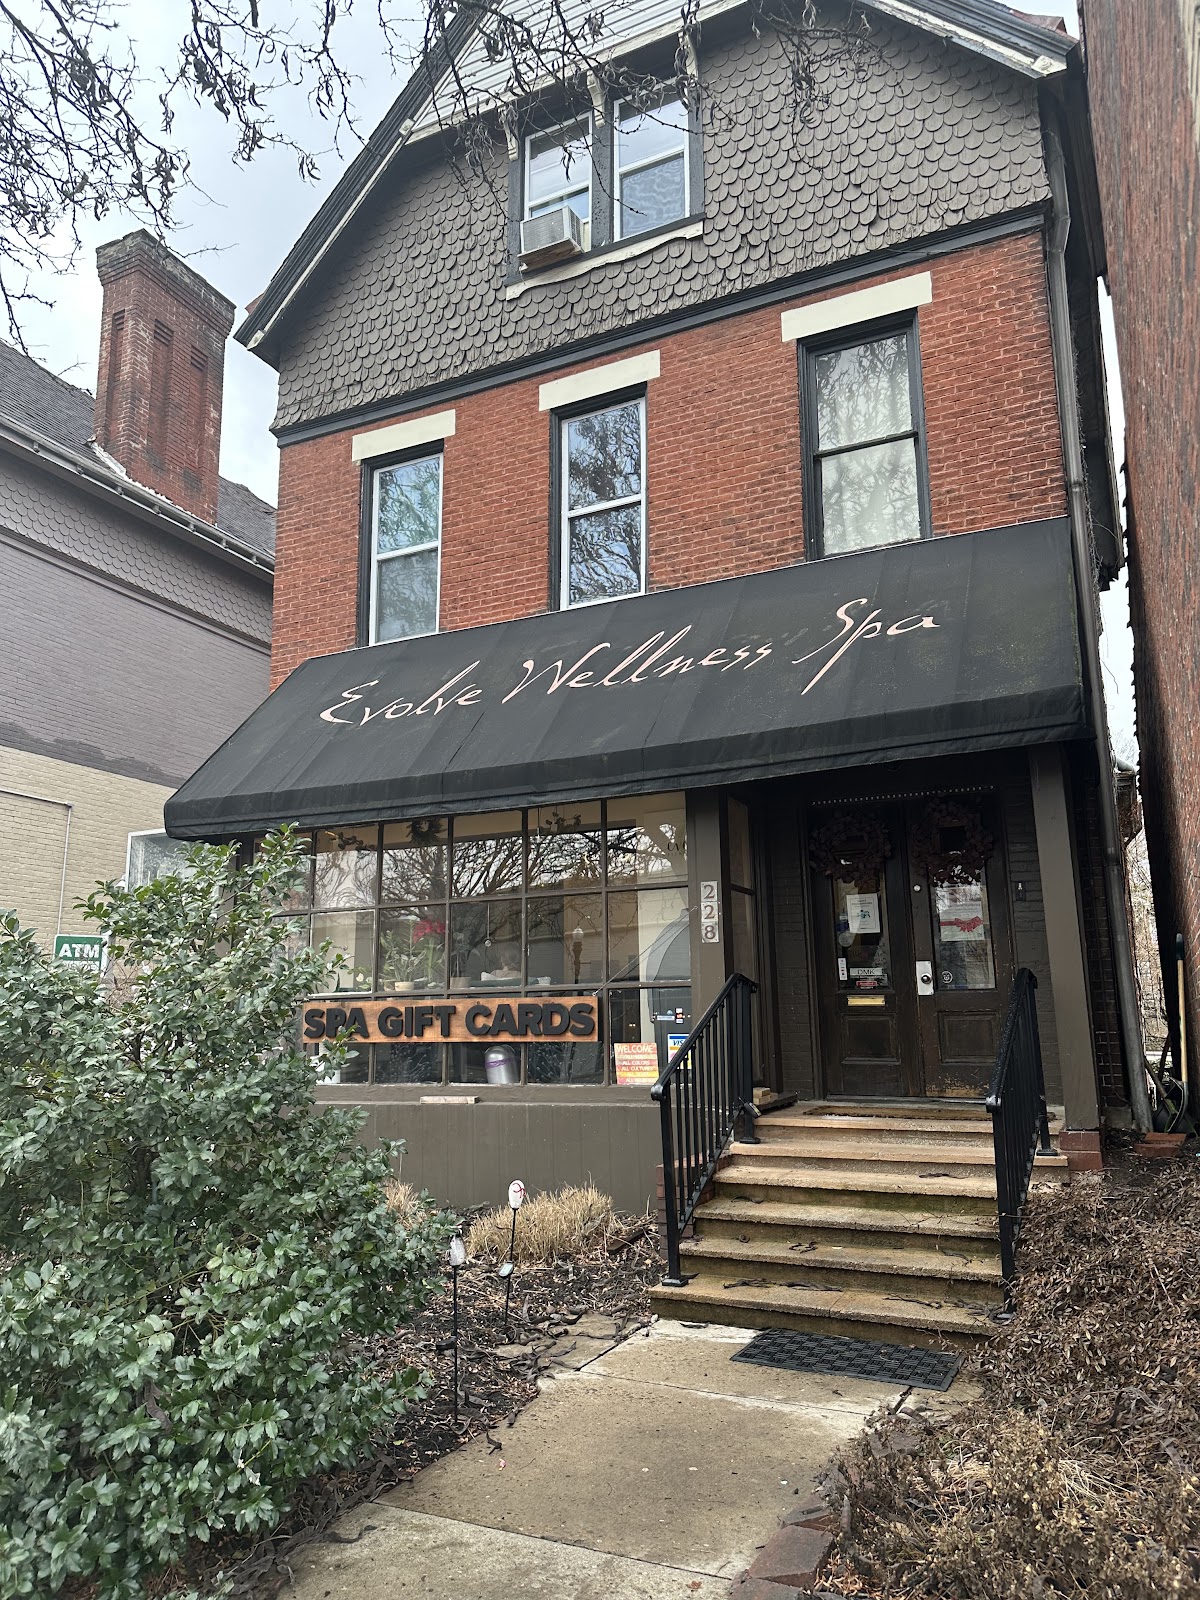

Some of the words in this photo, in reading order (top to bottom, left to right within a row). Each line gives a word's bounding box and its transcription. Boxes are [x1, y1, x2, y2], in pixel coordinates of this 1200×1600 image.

[319, 659, 484, 727] Evolve
[501, 624, 774, 704] Wellness
[792, 597, 941, 696] Spa
[703, 884, 717, 940] 228
[59, 943, 100, 958] ATM
[304, 1007, 370, 1039] SPA
[377, 1005, 456, 1038] GIFT
[465, 1003, 596, 1036] CARDS
[616, 1044, 653, 1054] WELCOME
